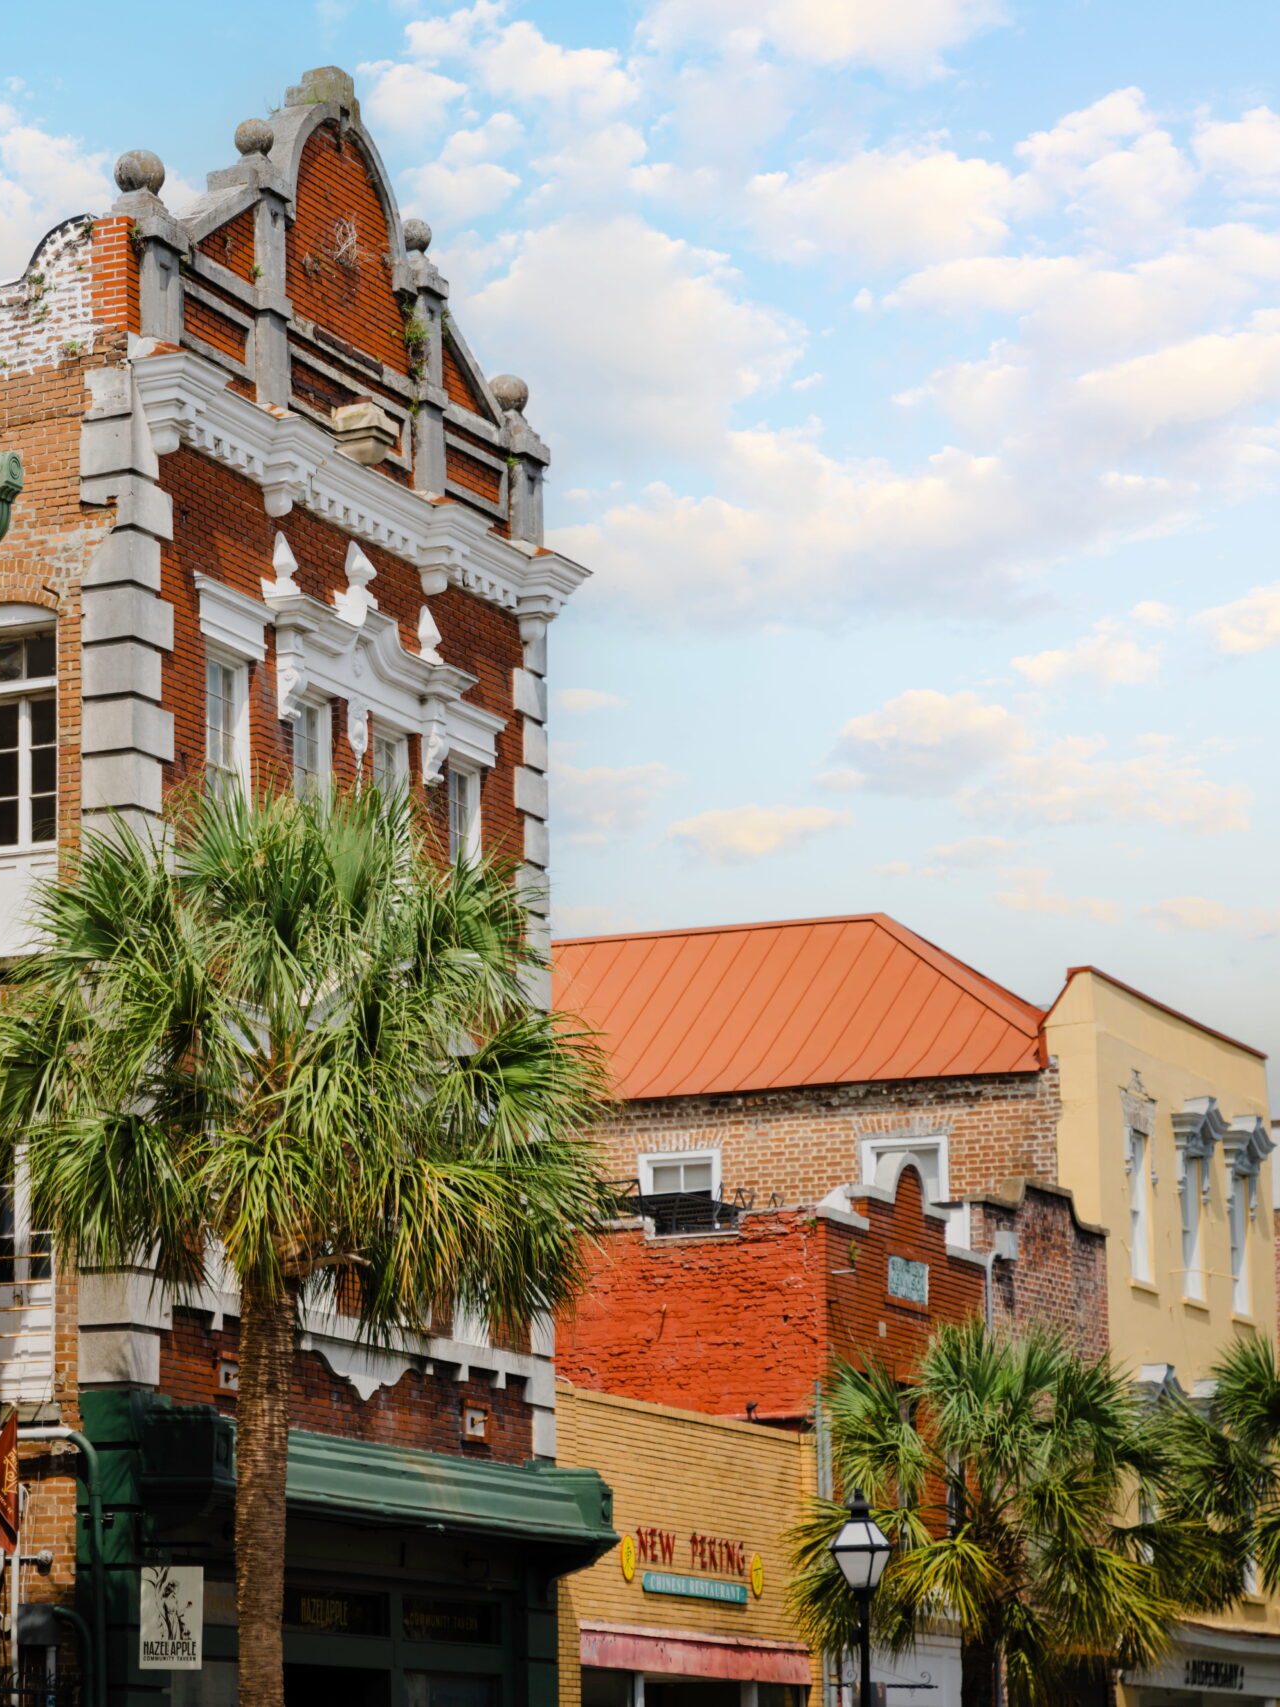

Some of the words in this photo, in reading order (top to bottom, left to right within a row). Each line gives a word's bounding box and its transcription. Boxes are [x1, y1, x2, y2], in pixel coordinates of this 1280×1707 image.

[636, 1527, 676, 1564] NEW
[689, 1532, 746, 1576] PEKING
[650, 1574, 687, 1593] CHINESE
[689, 1578, 741, 1600] RESTAURANT
